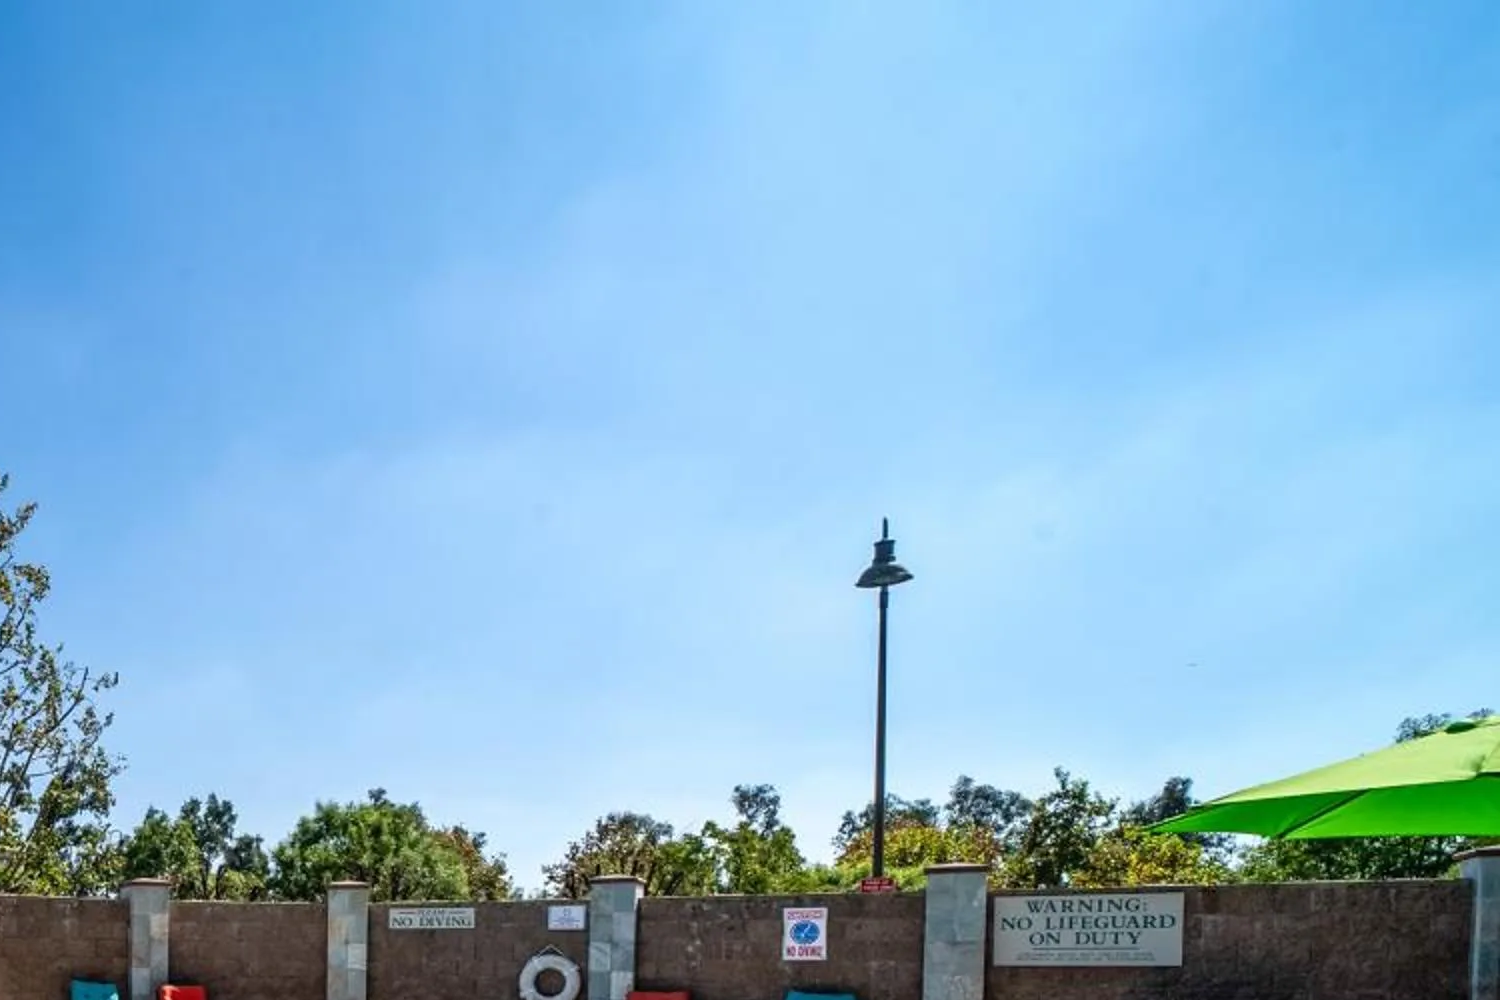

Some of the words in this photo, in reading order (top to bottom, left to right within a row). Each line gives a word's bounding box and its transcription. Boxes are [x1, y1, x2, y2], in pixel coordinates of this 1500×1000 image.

[1027, 898, 1148, 913] WARNING:
[392, 916, 413, 926] NO
[419, 915, 472, 926] DIVING
[1000, 917, 1033, 930] NO
[1045, 914, 1176, 930] LIFEGUARD
[1029, 932, 1061, 945] ON
[1075, 931, 1142, 945] DUTY
